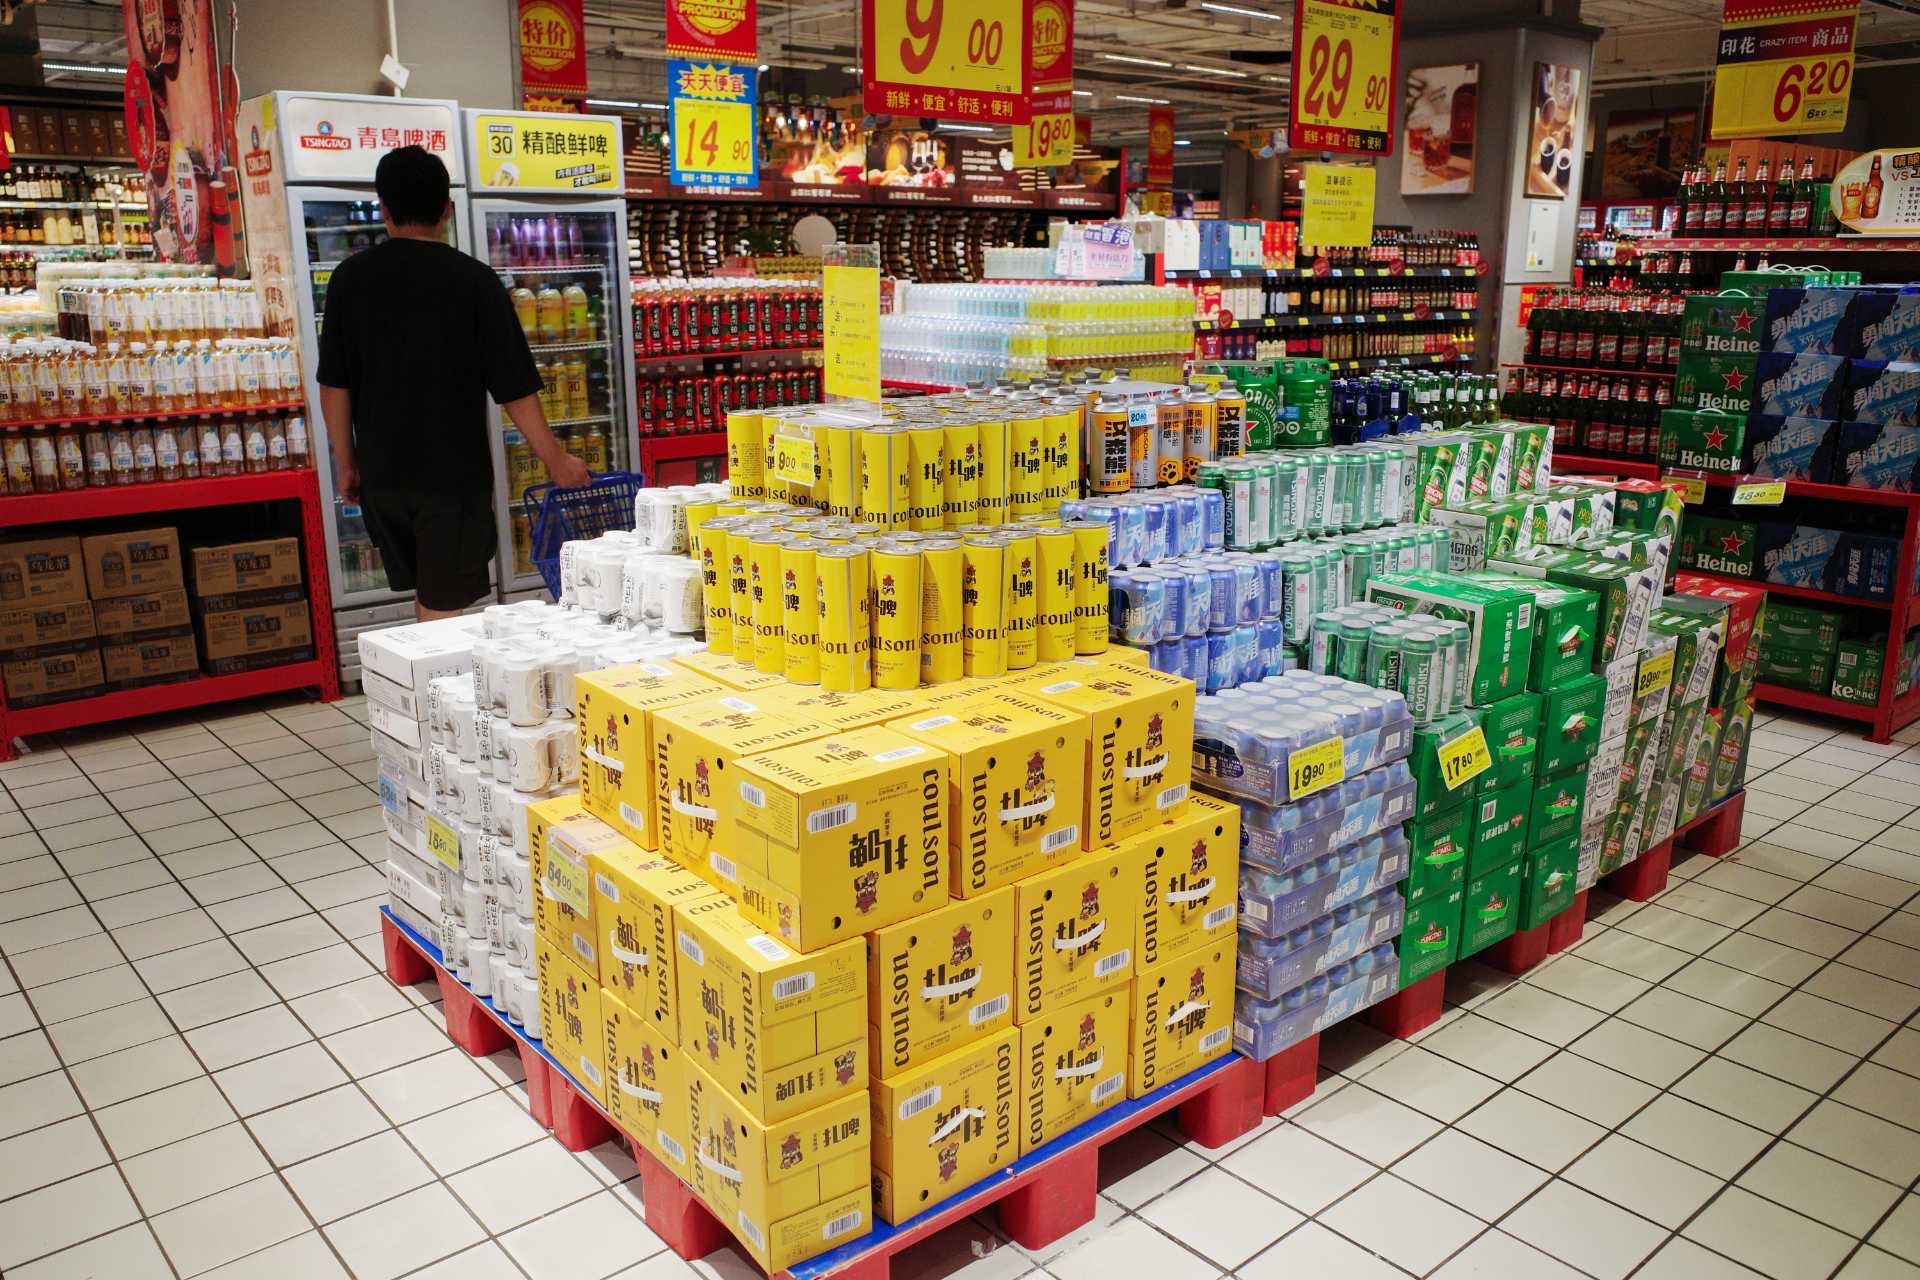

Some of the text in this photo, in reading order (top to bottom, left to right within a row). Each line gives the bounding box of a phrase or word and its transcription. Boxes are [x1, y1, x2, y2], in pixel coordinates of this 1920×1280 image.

[523, 17, 568, 46] 特价
[678, 4, 747, 22] PROMOTION
[968, 19, 1002, 65] 00
[1721, 26, 1848, 56] 印花 CRAZY ITEM 商品
[682, 73, 745, 93] 天天便宜
[1304, 34, 1388, 119] 29 90
[303, 137, 349, 149] TSINGTAO
[491, 135, 513, 154] 30
[523, 129, 608, 158] 精酿鲜啤
[685, 119, 750, 167] 14 90
[1771, 298, 1838, 340] 勇闯天涯
[1415, 663, 1428, 712] TSINGTAO
[658, 742, 673, 854] coulson
[922, 768, 942, 892] coulson
[970, 771, 987, 890] coulson
[1099, 731, 1116, 841] coulson
[1143, 860, 1158, 964] coulson
[653, 903, 670, 1018] coulson
[1026, 903, 1046, 1015] coulson
[741, 971, 758, 1094] coulson
[890, 950, 909, 1068] coulson
[1143, 990, 1159, 1090] coulson
[996, 1042, 1013, 1150] coulson
[1029, 1039, 1045, 1146] coulson
